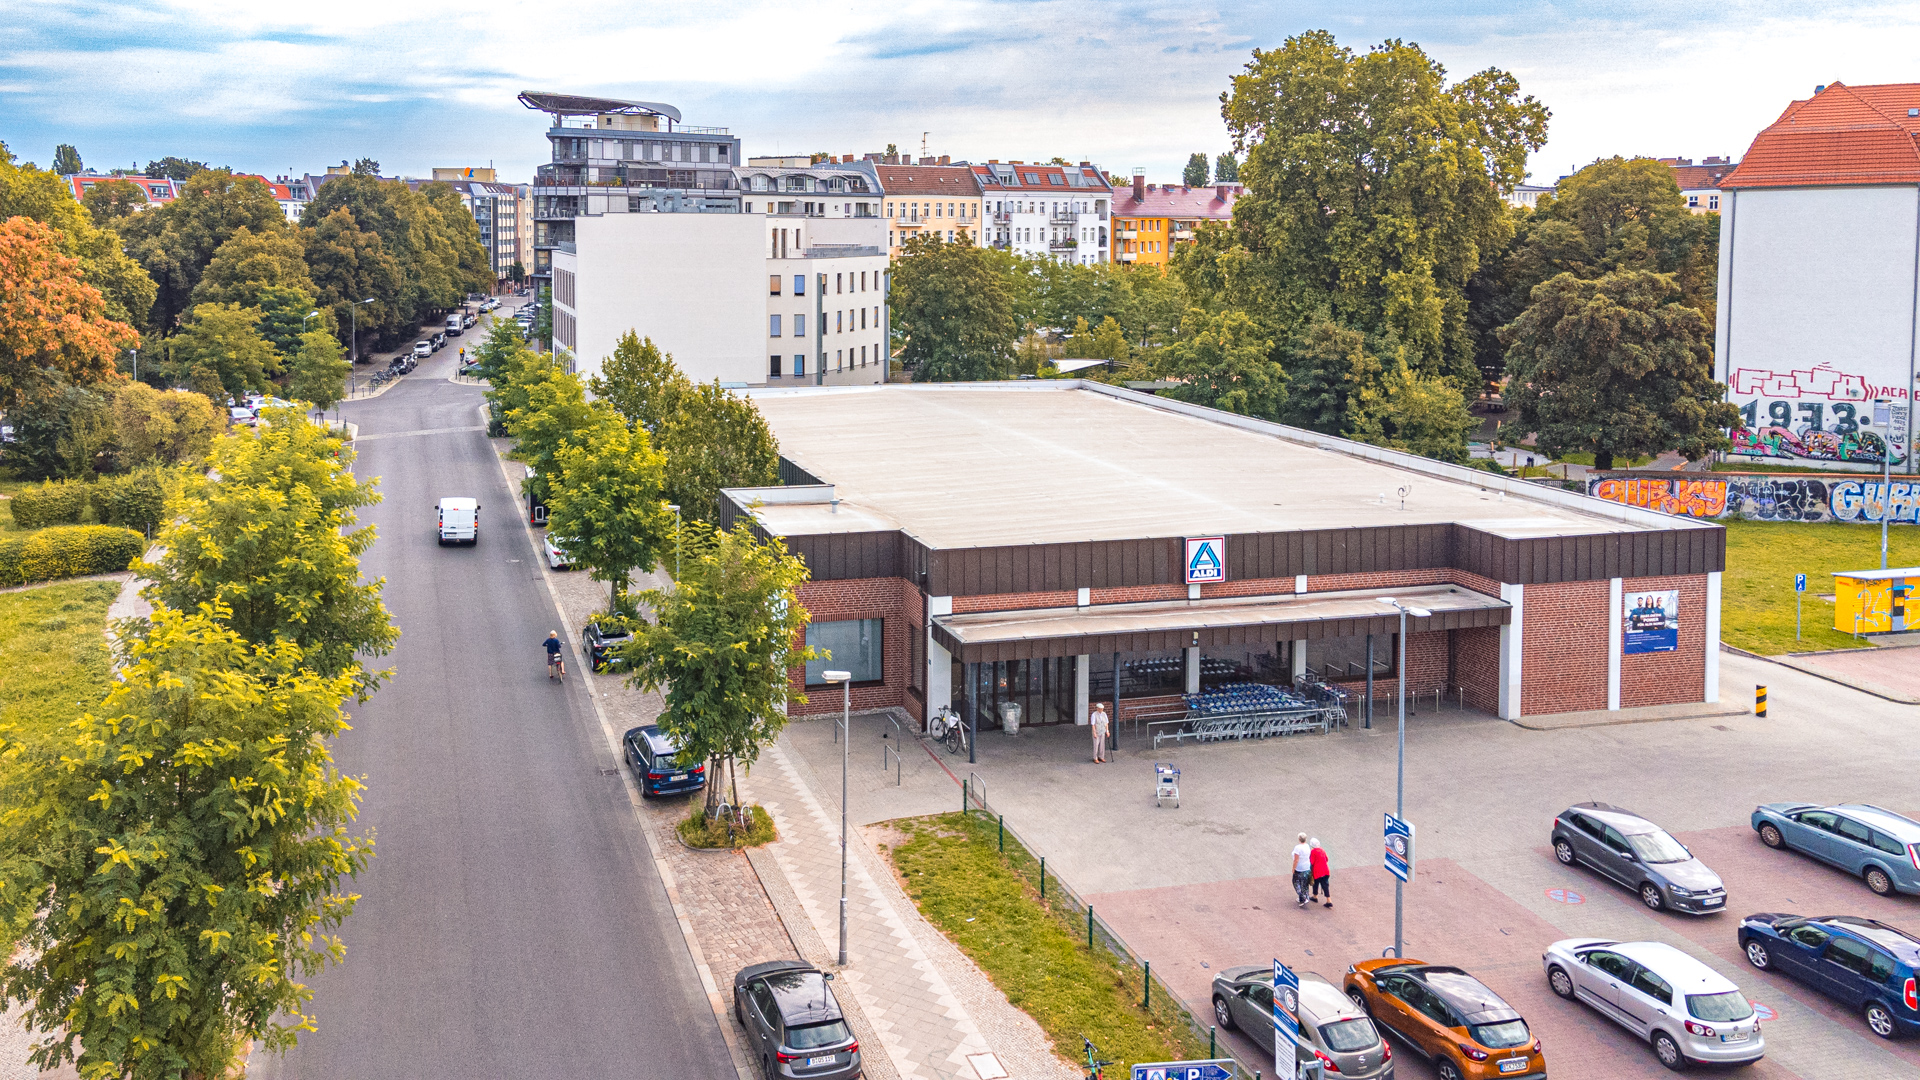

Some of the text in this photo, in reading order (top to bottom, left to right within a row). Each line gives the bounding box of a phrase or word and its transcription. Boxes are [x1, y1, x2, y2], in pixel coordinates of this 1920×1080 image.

[1192, 569, 1218, 578] ALDI
[1798, 574, 1804, 584] P
[1386, 815, 1393, 830] P
[1274, 961, 1282, 980] P
[1188, 1068, 1200, 1080] P
